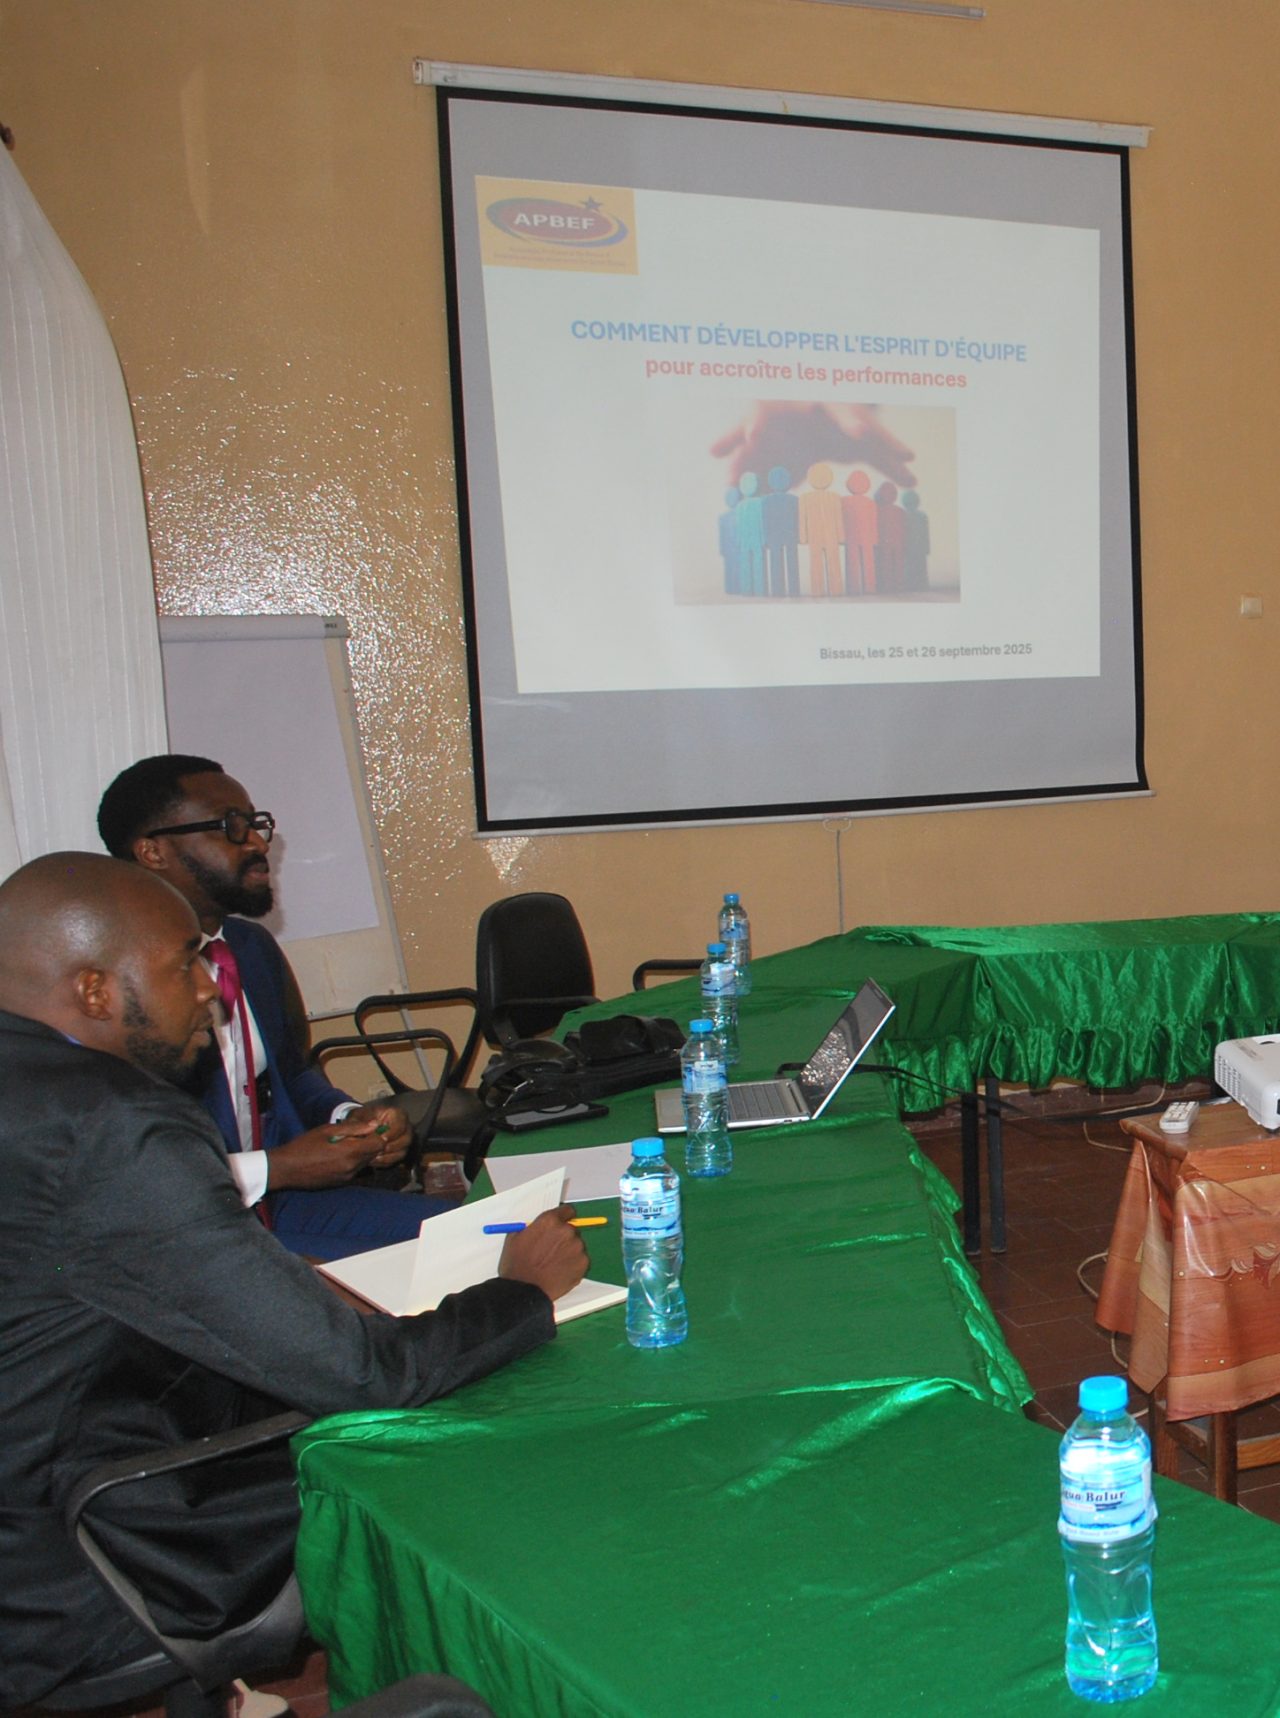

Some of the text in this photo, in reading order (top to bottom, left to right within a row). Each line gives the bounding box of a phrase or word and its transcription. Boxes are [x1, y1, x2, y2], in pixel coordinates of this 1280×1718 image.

[513, 212, 595, 230] APBEF
[570, 319, 1028, 363] COMMENT DÉVELOPPER L'ESPRIT D'ÉQUIPE
[645, 358, 968, 389] pour accroître les performances
[819, 642, 1033, 661] Bissau, les 25 et 26 septembre 2025
[1085, 1490, 1126, 1502] Balur
